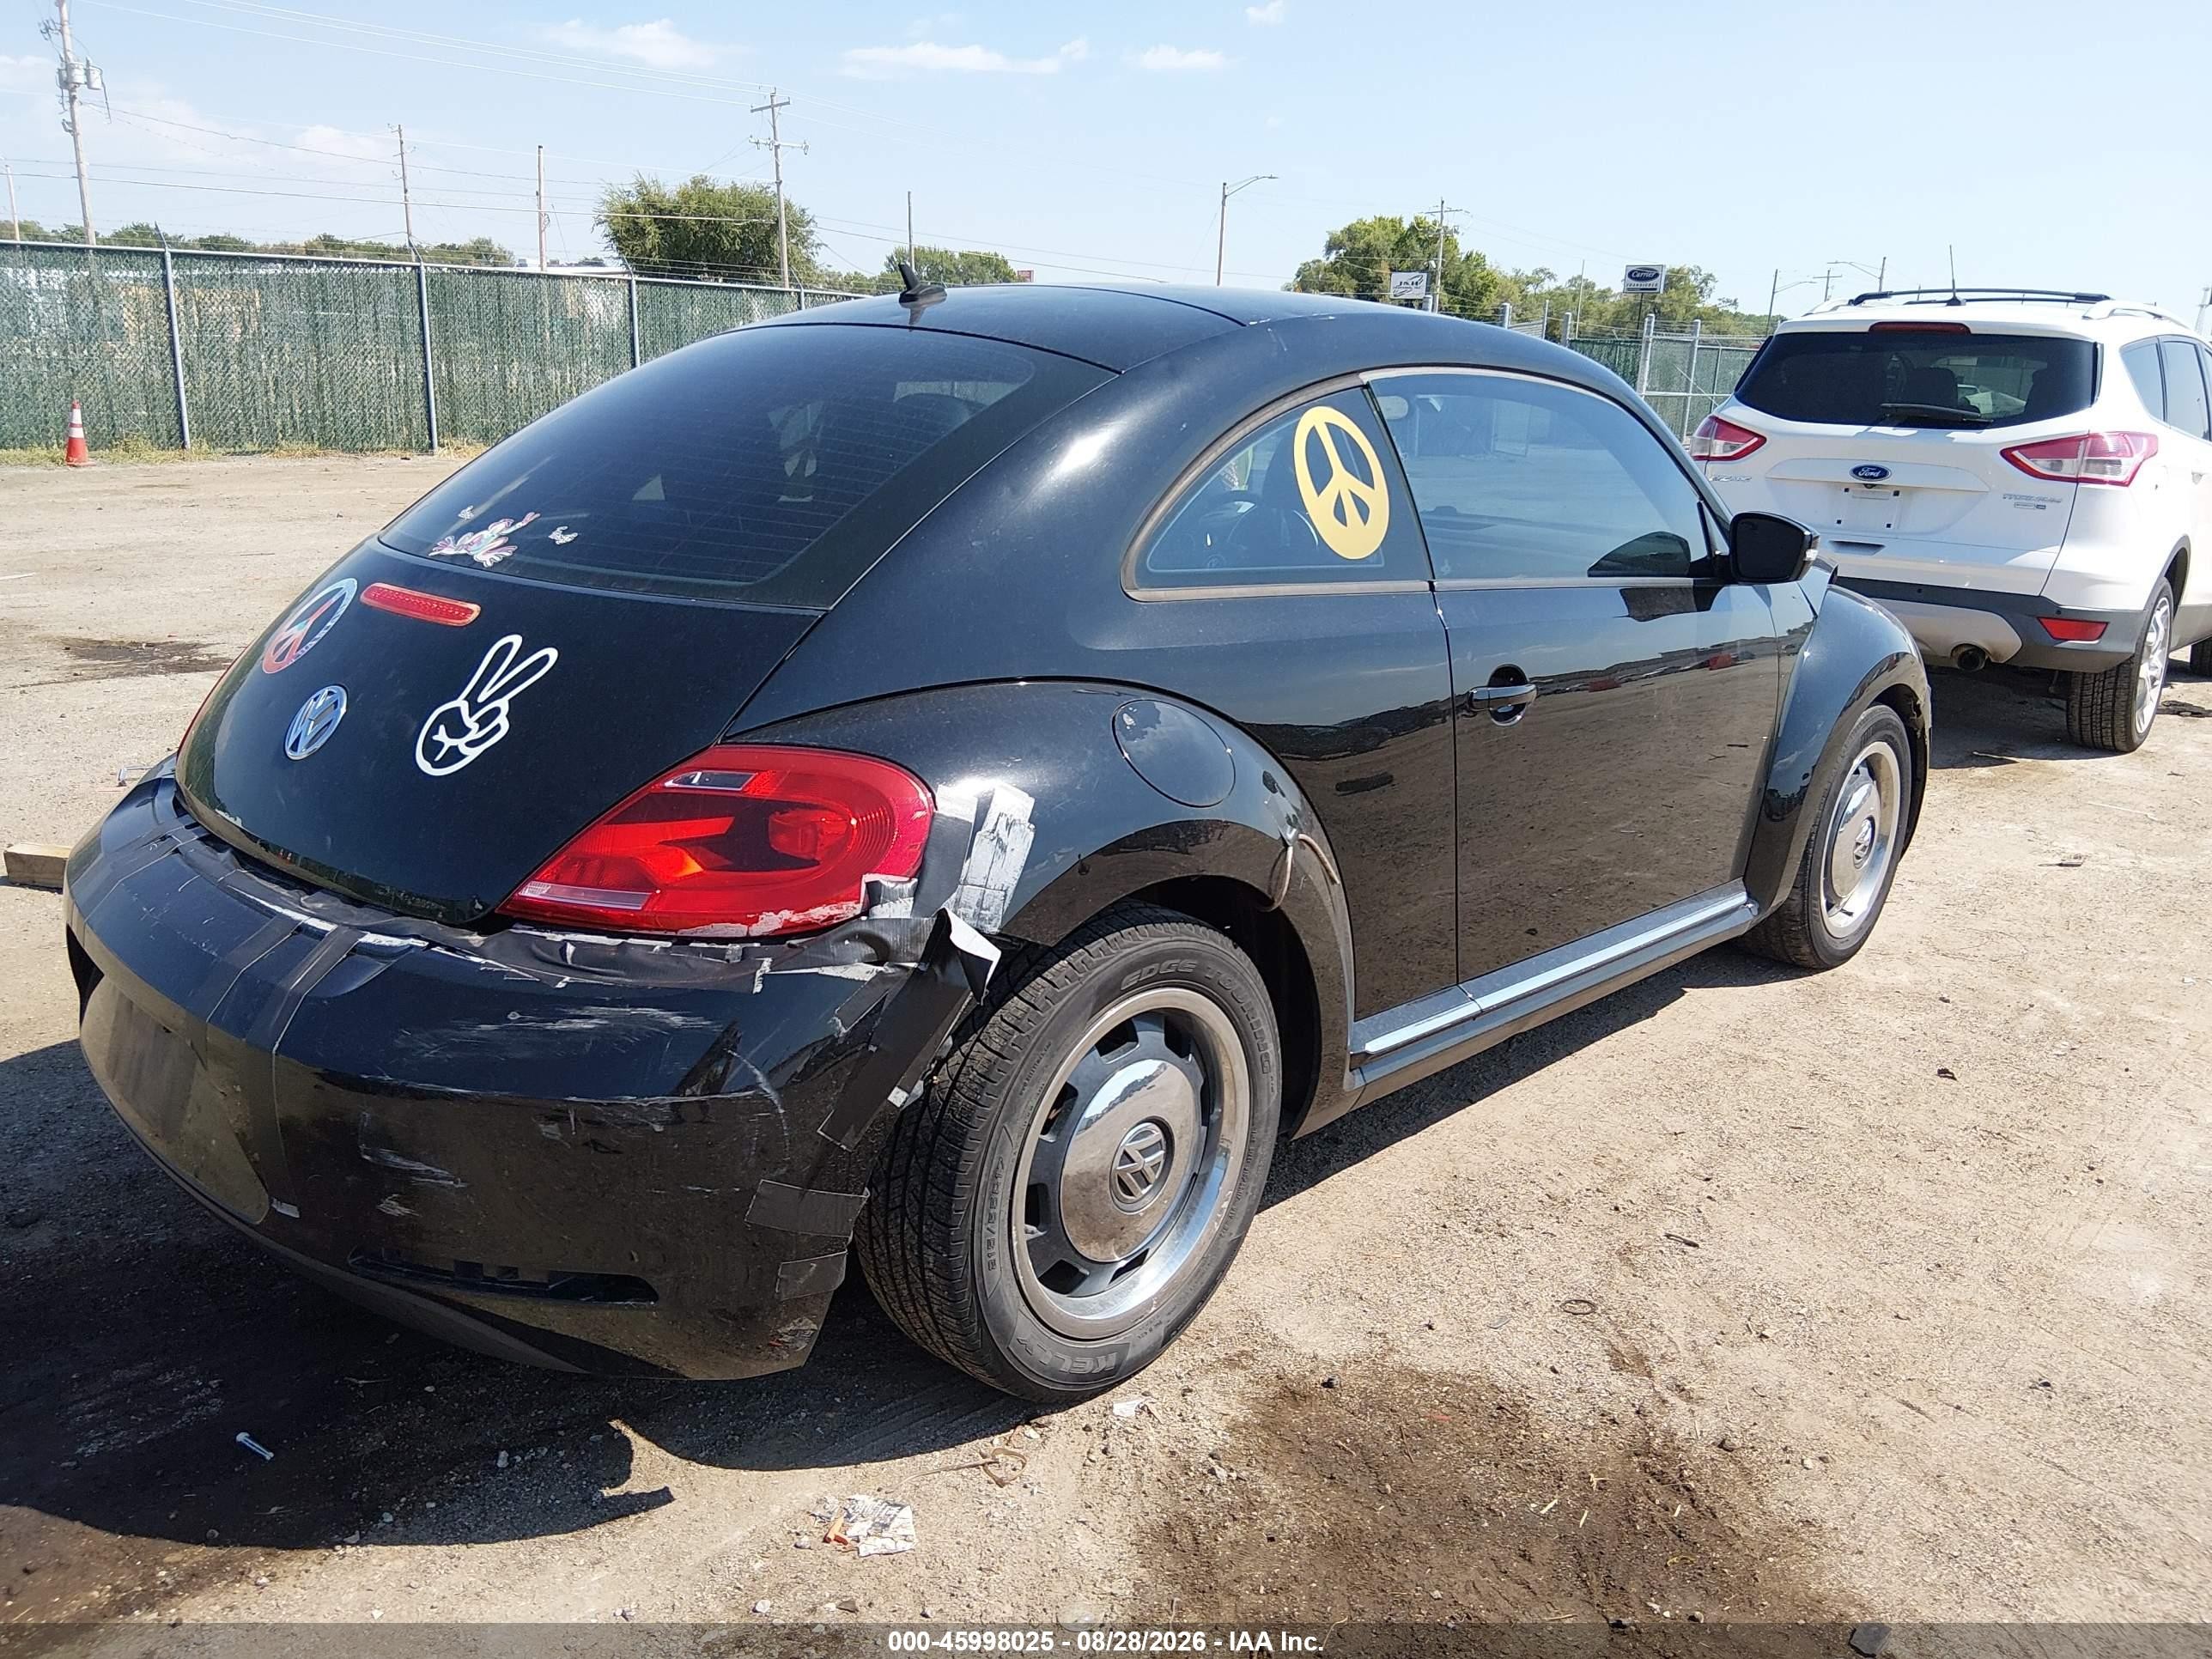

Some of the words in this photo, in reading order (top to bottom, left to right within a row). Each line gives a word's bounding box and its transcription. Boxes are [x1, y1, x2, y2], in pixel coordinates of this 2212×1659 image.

[1857, 466, 1881, 477] Ford
[1120, 958, 1198, 991] EDGE
[1204, 966, 1272, 1075] TOURING
[1016, 1336, 1118, 1375] KELLY
